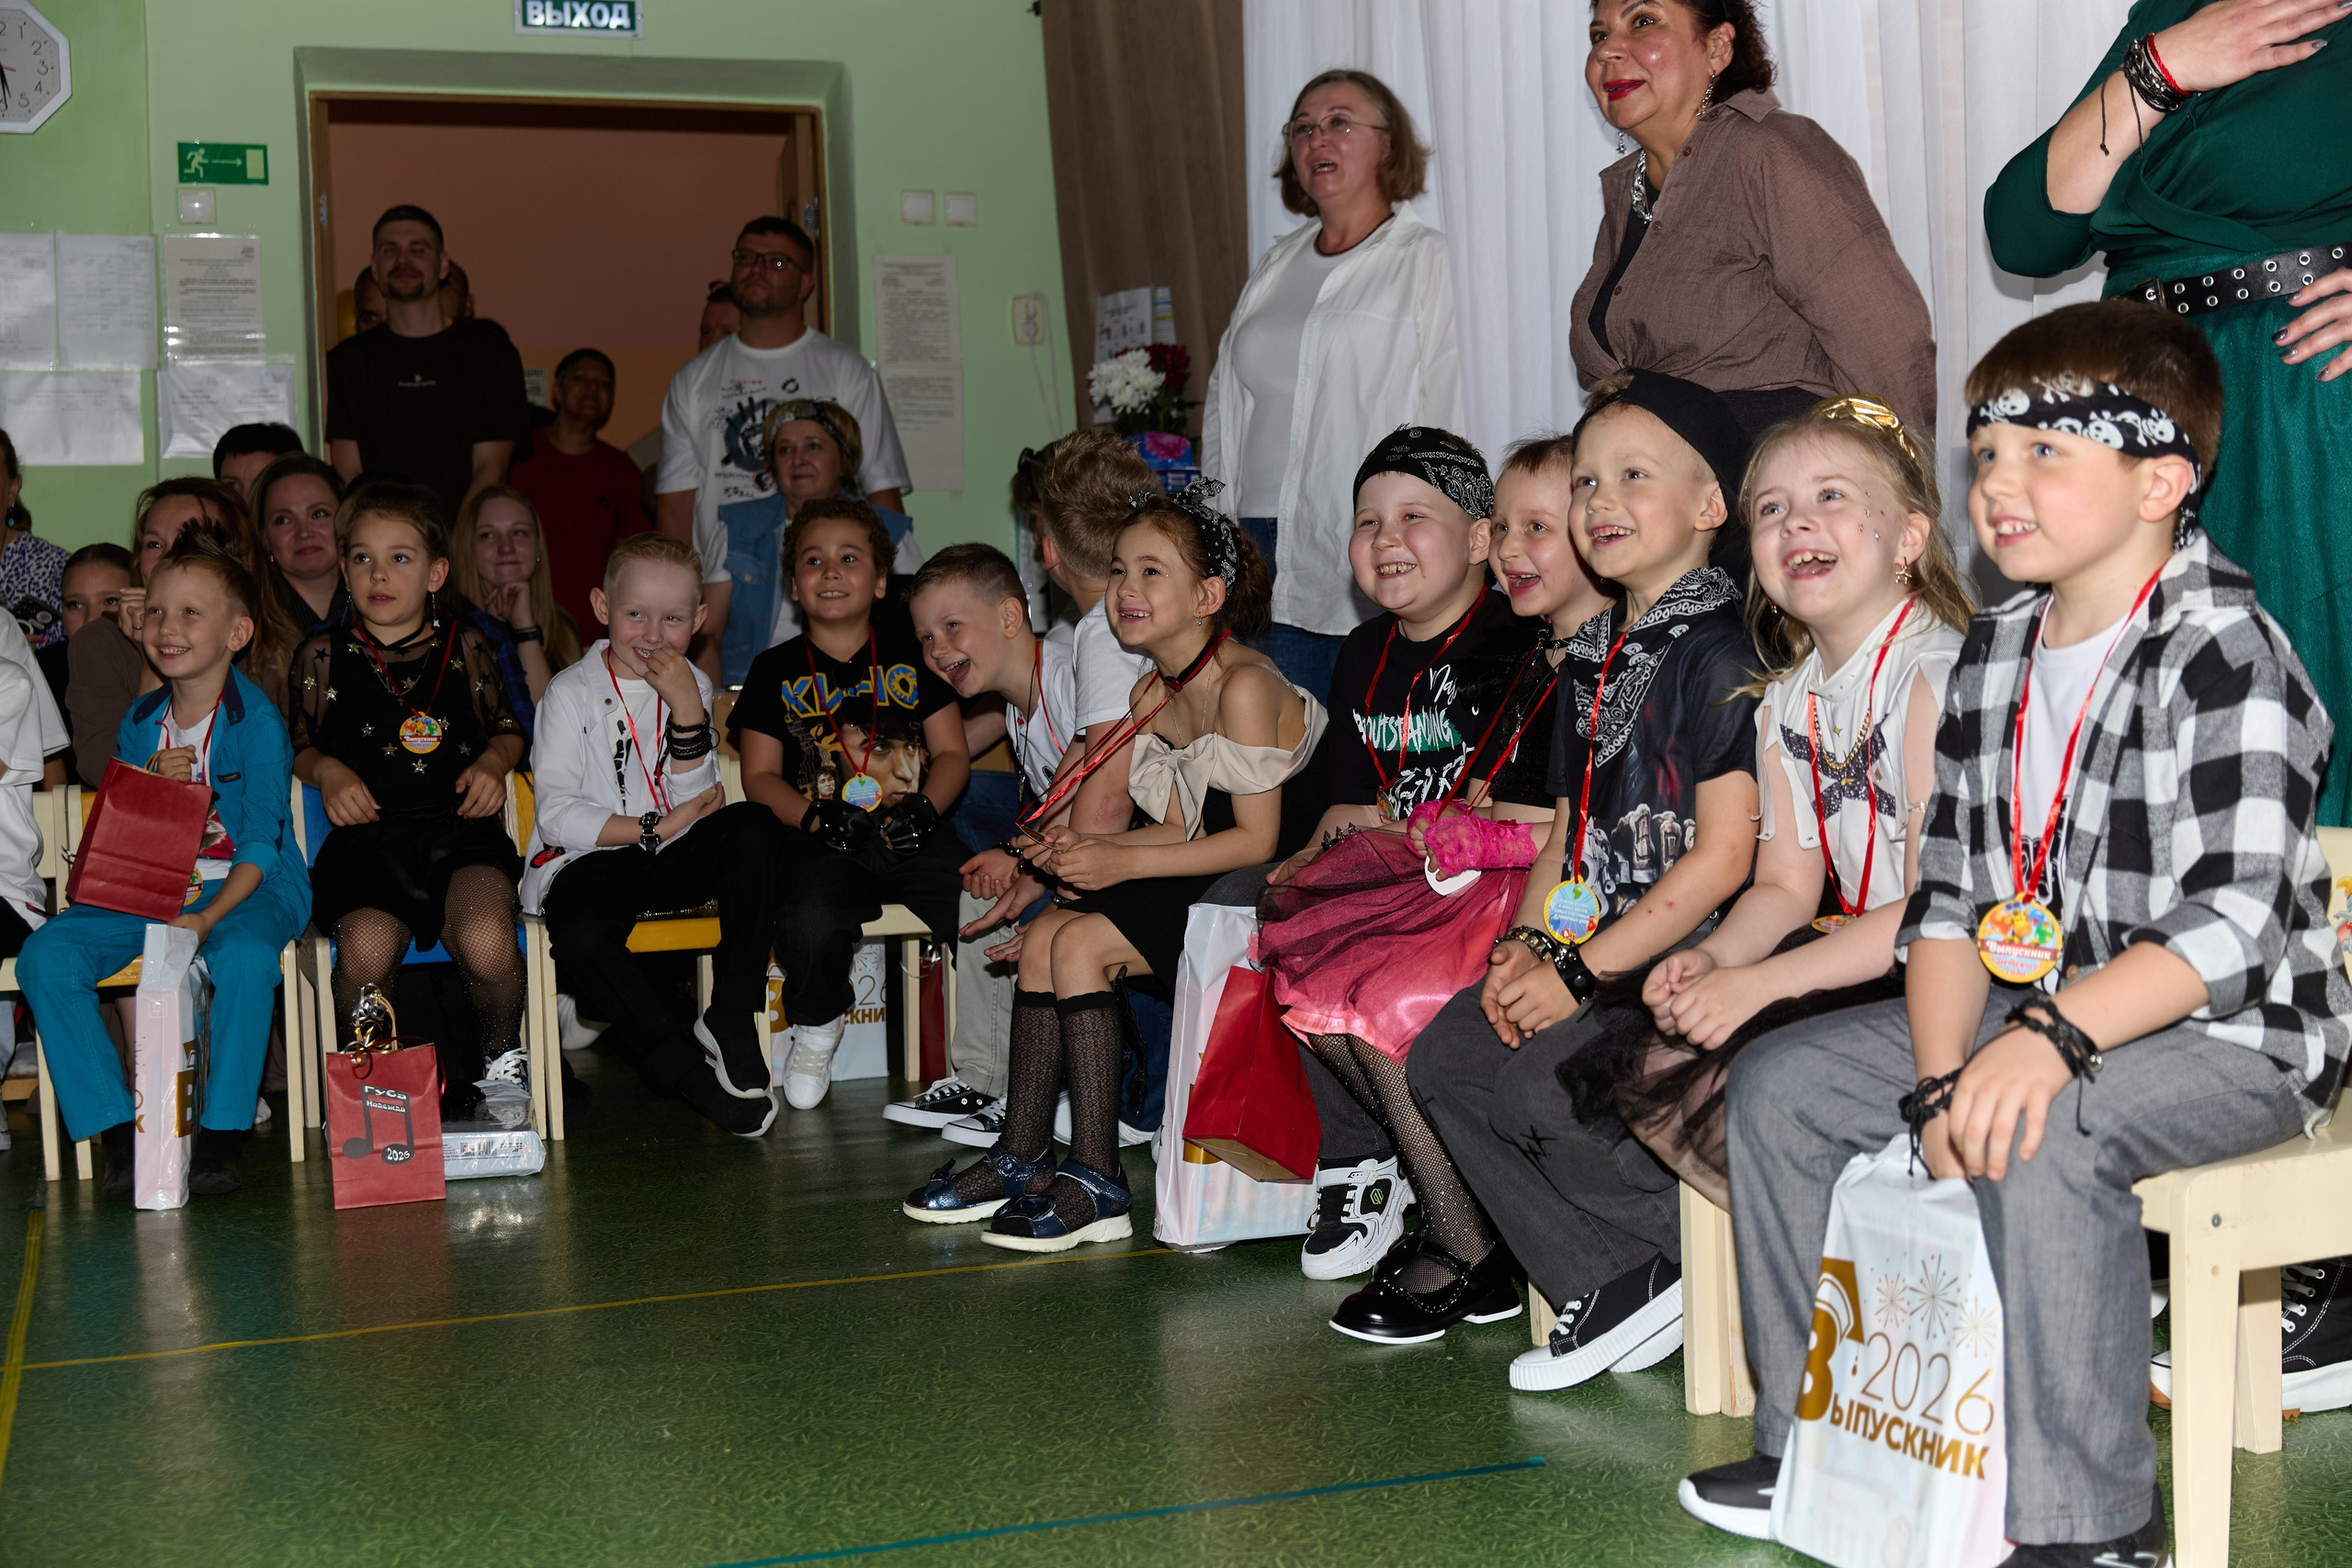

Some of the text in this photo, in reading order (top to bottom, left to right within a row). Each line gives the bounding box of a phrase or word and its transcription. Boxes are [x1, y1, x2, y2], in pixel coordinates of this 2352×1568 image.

[526, 0, 631, 28] ВЫХОД
[31, 39, 42, 55] 2
[37, 60, 49, 75] 3
[34, 80, 43, 94] 4
[18, 93, 29, 108] 5
[1985, 941, 2052, 960] Выпускник
[1995, 956, 2039, 970] Детского
[365, 1086, 407, 1100] Губа
[367, 1100, 406, 1112] Надежда
[387, 1147, 411, 1161] 2026
[1860, 1332, 1995, 1436] 2026
